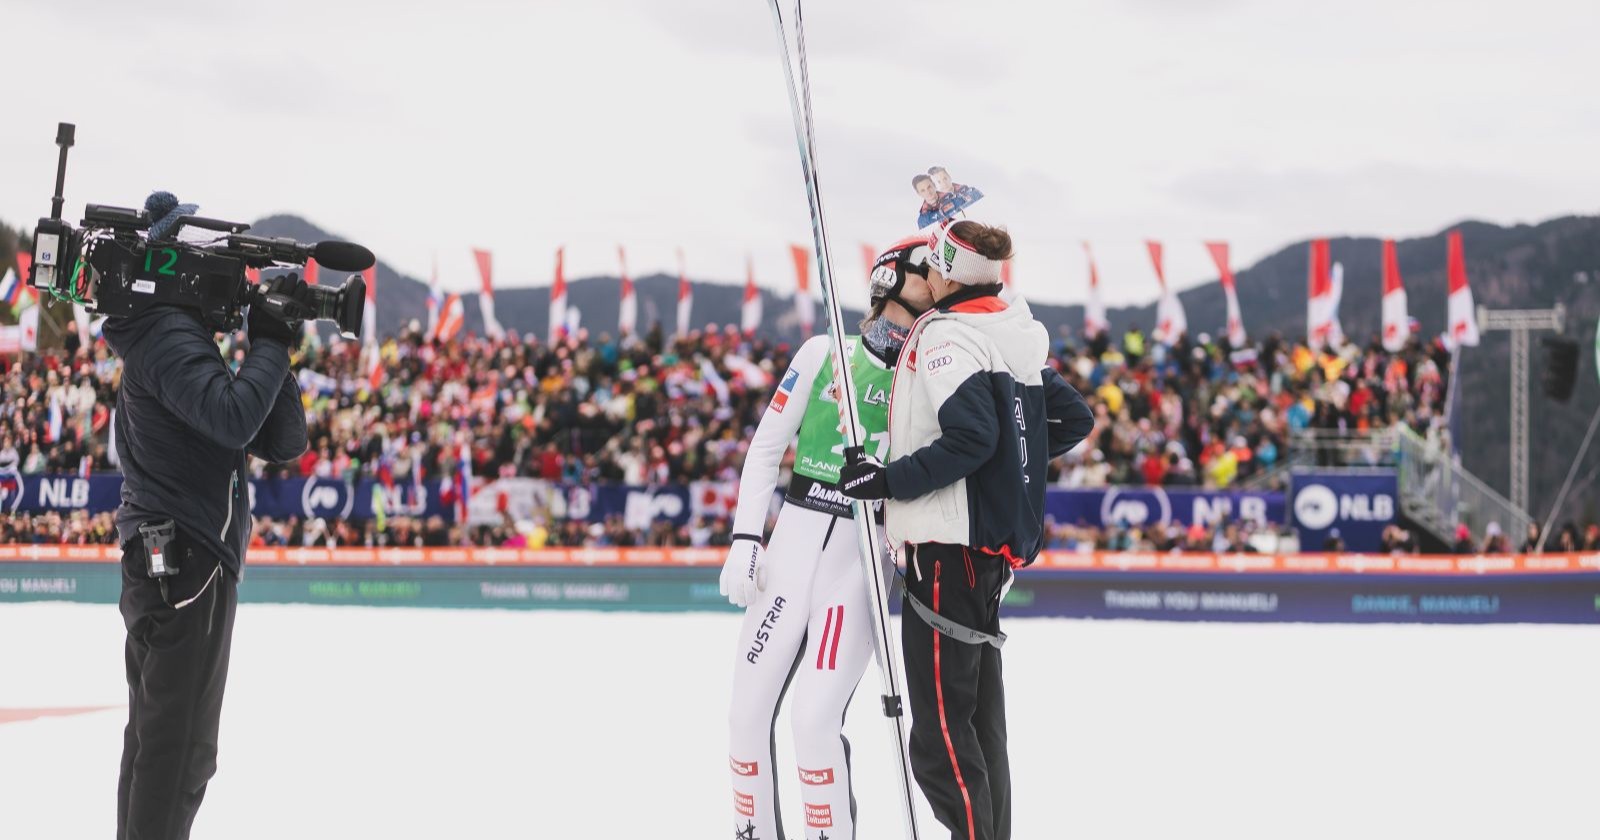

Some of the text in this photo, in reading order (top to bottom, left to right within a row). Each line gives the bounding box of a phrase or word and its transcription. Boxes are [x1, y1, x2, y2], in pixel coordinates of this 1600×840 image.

[144, 247, 177, 275] 12
[39, 478, 90, 508] NLB
[1339, 493, 1394, 521] NLB
[747, 596, 787, 664] AUSTRIA
